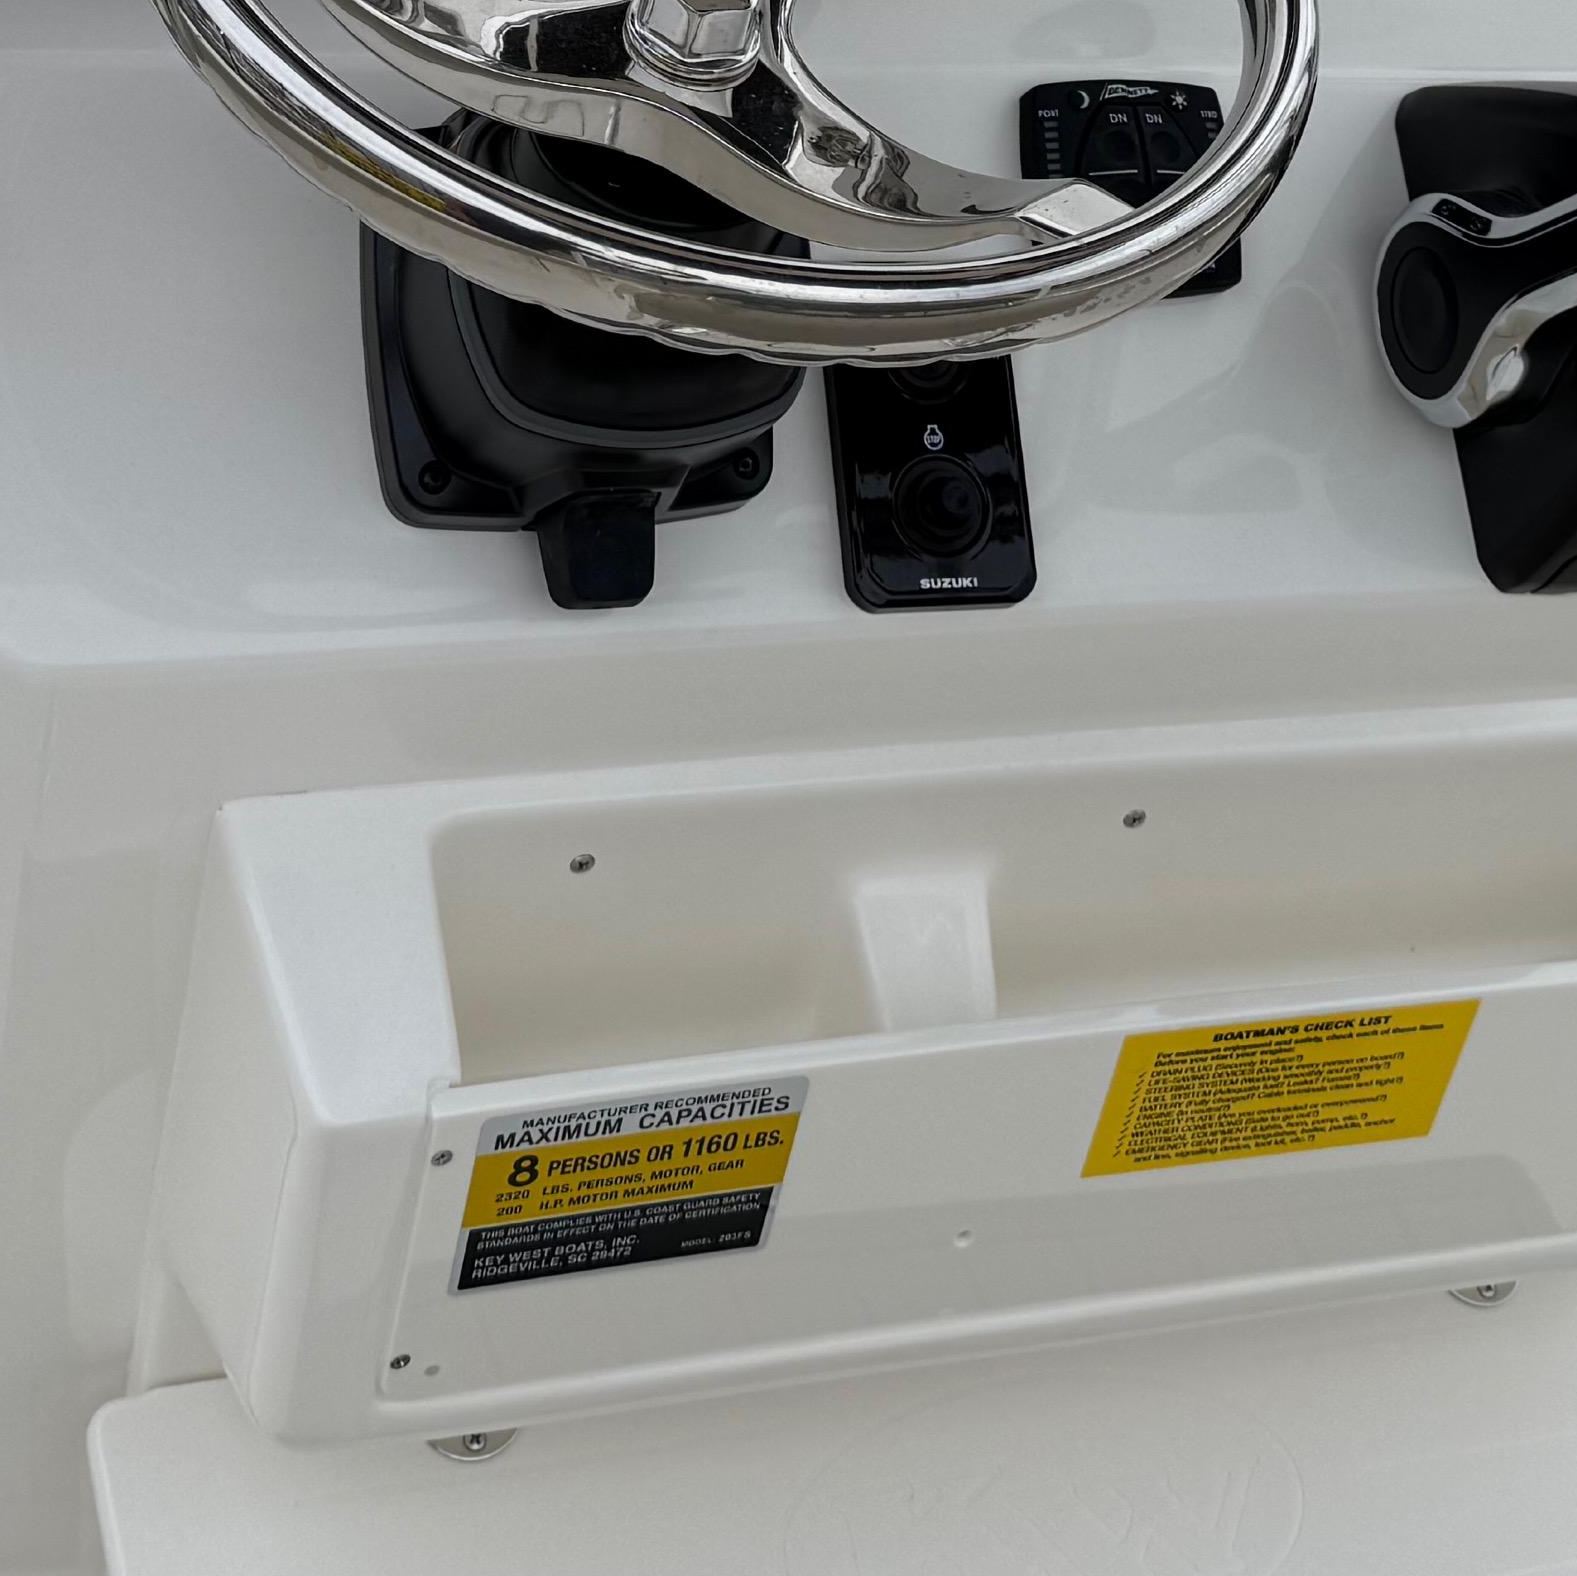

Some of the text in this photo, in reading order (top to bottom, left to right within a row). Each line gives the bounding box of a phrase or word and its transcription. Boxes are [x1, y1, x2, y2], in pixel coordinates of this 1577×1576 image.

[1038, 109, 1059, 118] PORT
[1109, 113, 1128, 123] DN
[1145, 113, 1163, 124] DN
[920, 576, 979, 590] SUZUKI
[1213, 1025, 1299, 1041] BOATMAN'S
[1304, 1020, 1354, 1032] CHECK
[1359, 1016, 1390, 1026] LIST
[495, 1094, 790, 1150] MAXIMUM CAPACITIES
[523, 1086, 771, 1128] MANUFACTURER RECOMMENDED
[508, 1129, 786, 1187] 8 PERSONS OR 1160 LBS.
[496, 1159, 744, 1202] 2320 LBS. PERSONS, MOTOR, GEAR
[497, 1205, 521, 1216] 200
[568, 1191, 617, 1206] MOTOR
[623, 1181, 693, 1198] MAXIMUM
[477, 1202, 759, 1248] STANDARDS IN EFFECT ON THE DATE OF CERTIFICATION
[481, 1229, 503, 1238] THIS
[508, 1225, 533, 1235] BOAT
[538, 1217, 591, 1230] COMPLIES
[594, 1213, 620, 1222] WITH
[646, 1204, 680, 1215] COAST
[683, 1199, 718, 1210] GUARD
[721, 1193, 759, 1204] SAFETY
[472, 1256, 562, 1278] RIDGEVILLE,
[568, 1253, 586, 1264] SC
[474, 1234, 640, 1266] KEY WEST BOATS, INC.
